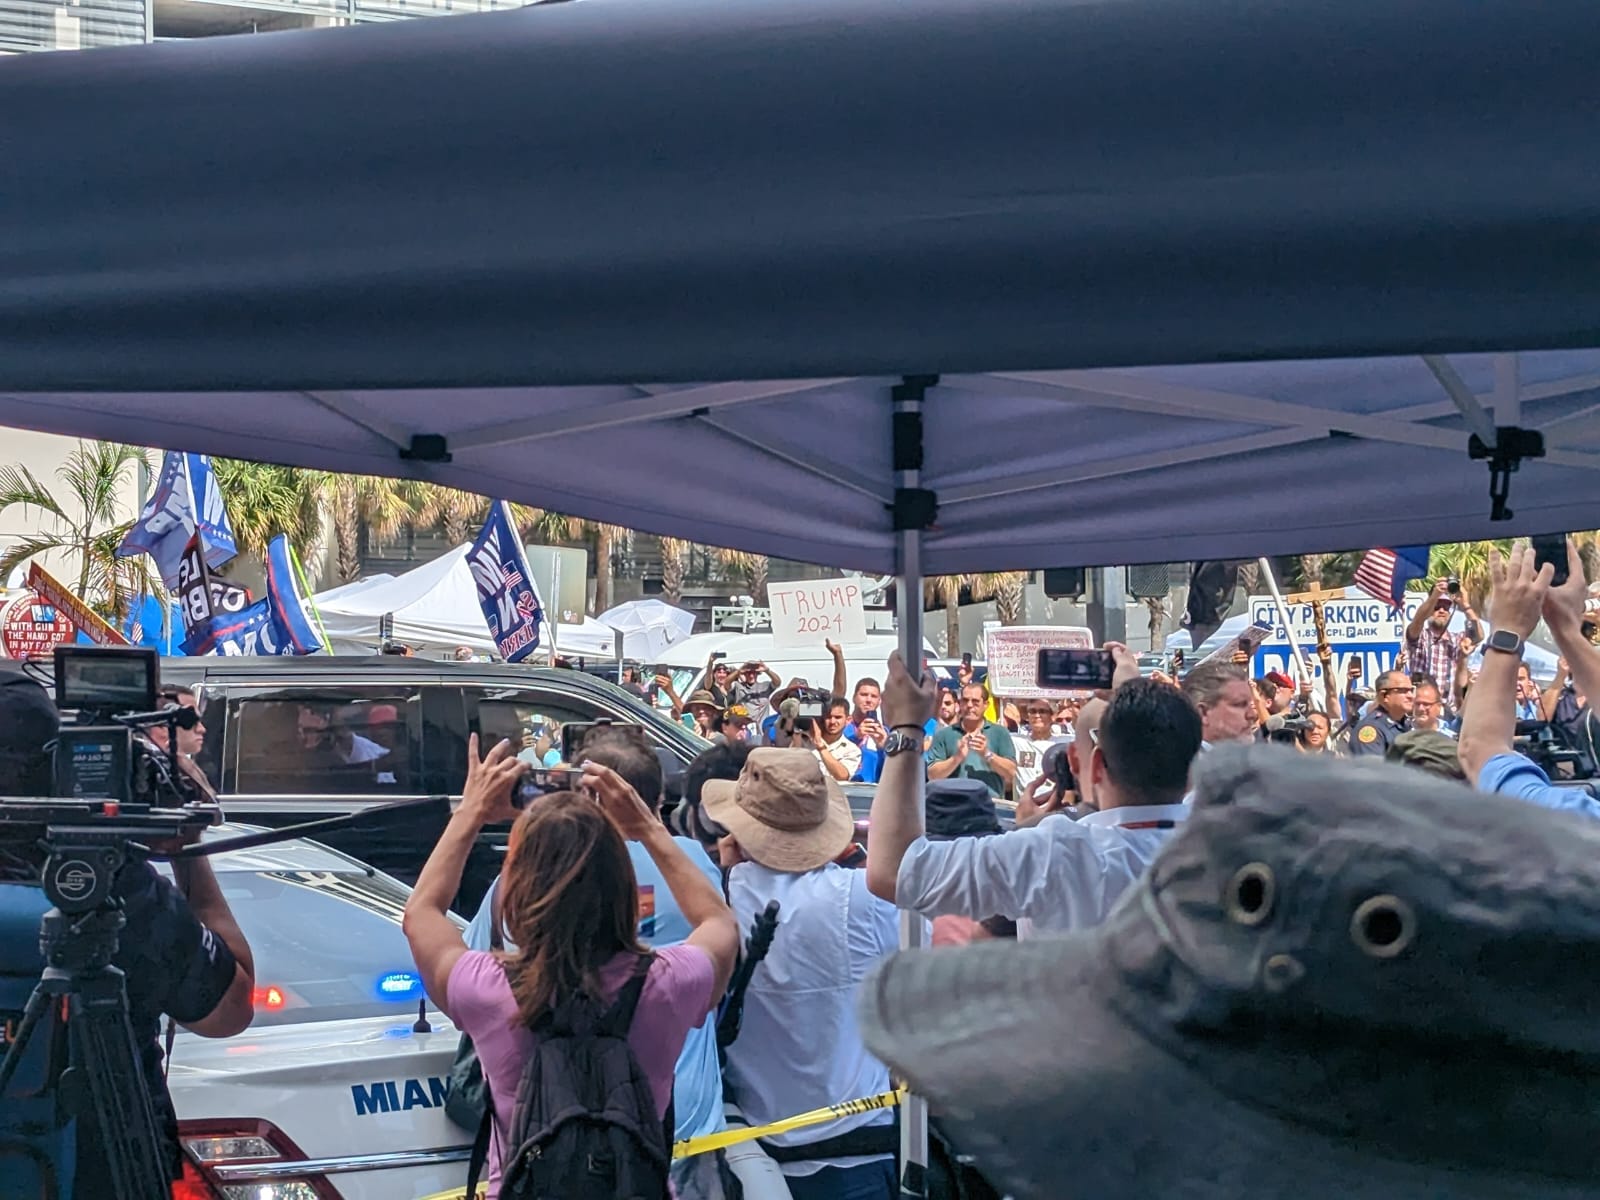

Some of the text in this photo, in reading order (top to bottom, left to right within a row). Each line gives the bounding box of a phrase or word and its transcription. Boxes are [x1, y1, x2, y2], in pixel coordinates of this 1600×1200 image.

[772, 585, 858, 615] TRUMP
[1302, 604, 1380, 625] PRKING
[10, 621, 33, 632] WITH
[797, 613, 843, 633] 2024
[8, 631, 66, 642] THE HAND GOT
[9, 641, 18, 649] IN
[20, 641, 34, 650] MY
